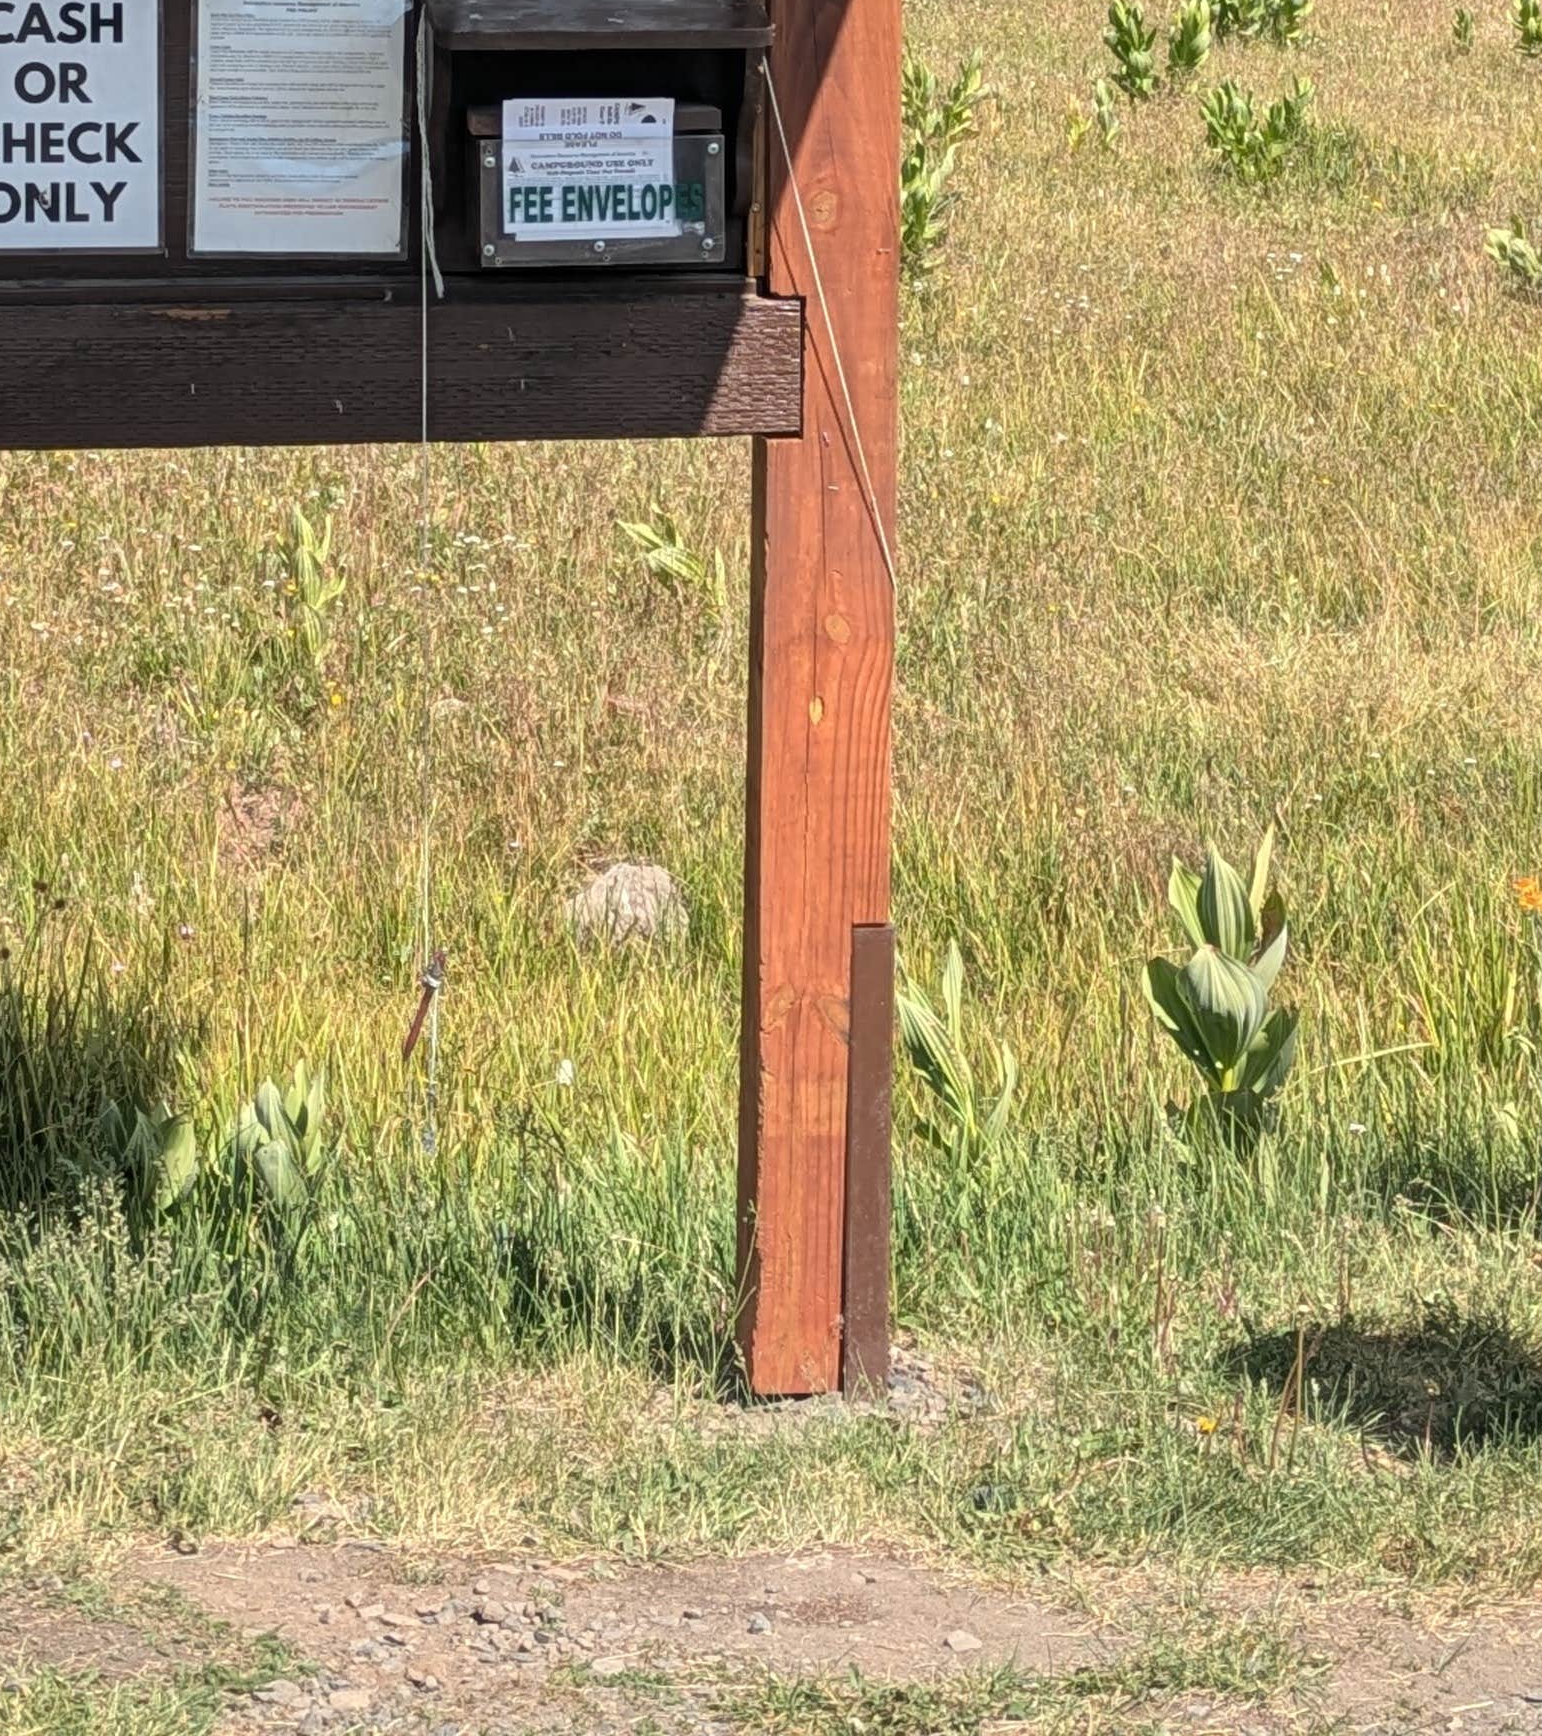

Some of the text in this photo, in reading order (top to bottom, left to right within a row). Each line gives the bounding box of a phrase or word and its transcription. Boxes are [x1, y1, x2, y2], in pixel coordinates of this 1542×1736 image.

[14, 62, 92, 104] OR
[531, 158, 654, 169] CAMPGROUND USE ONLY
[509, 183, 705, 223] FEE ENVELOPES
